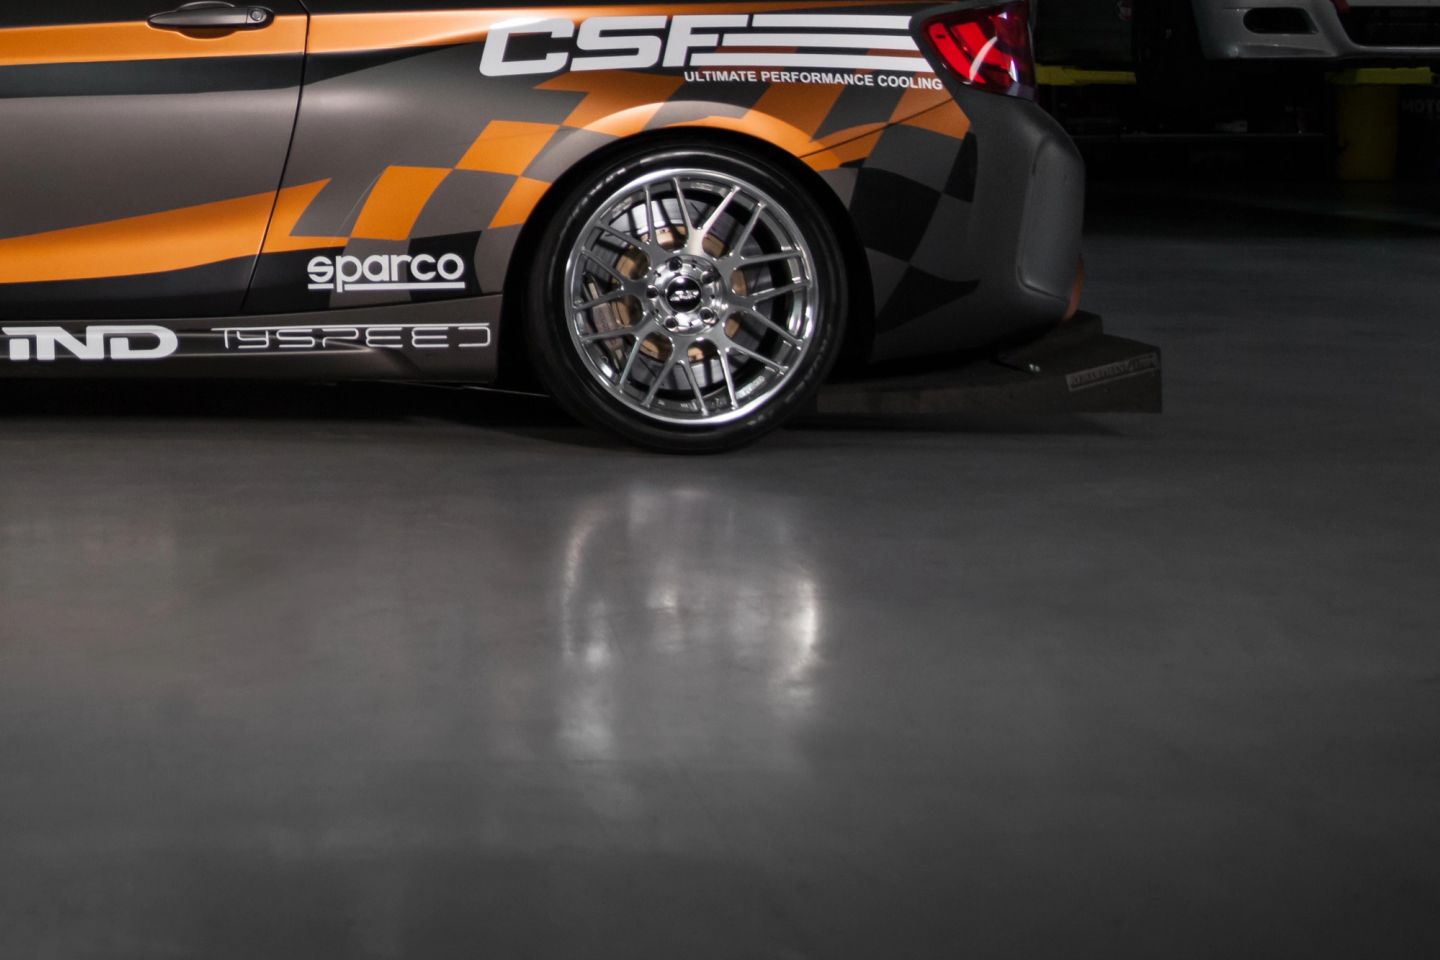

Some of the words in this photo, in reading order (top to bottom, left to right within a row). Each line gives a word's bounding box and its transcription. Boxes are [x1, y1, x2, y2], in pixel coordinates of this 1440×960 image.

[479, 14, 750, 76] CSF
[684, 70, 758, 83] ULTIMATE
[760, 71, 874, 87] PERFORMANCE
[877, 74, 944, 91] COOLING
[307, 252, 465, 291] sparco
[210, 321, 491, 350] TYSPEED
